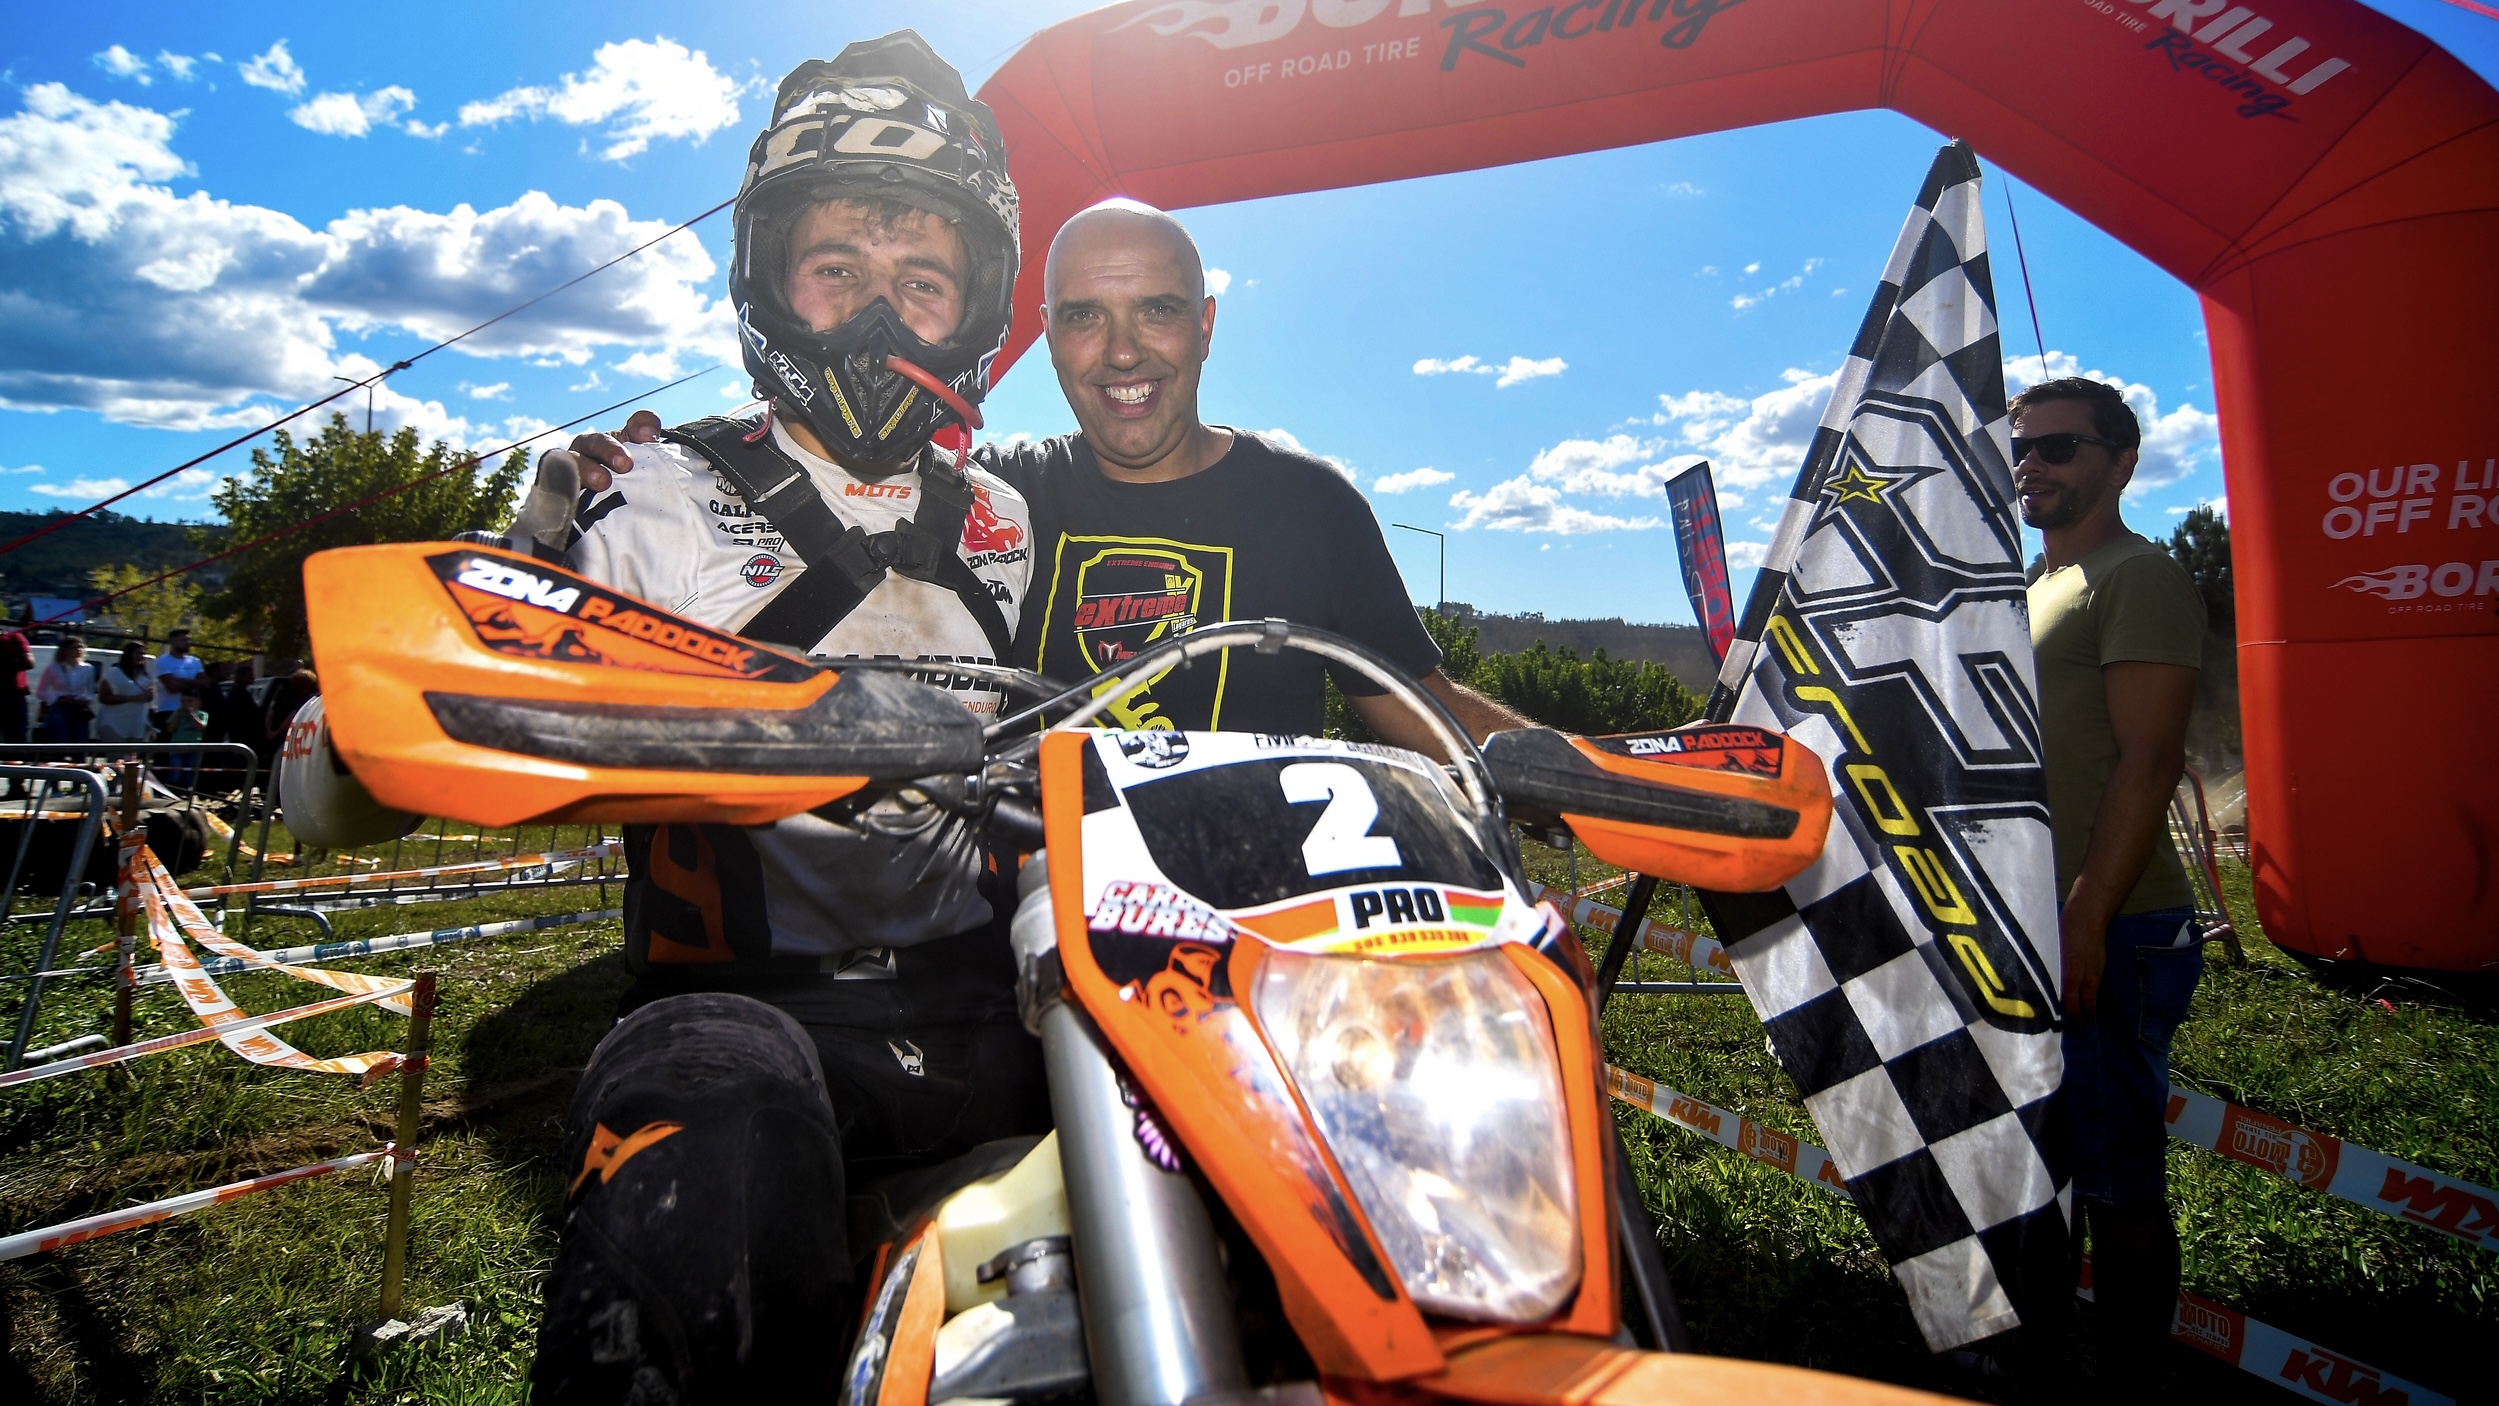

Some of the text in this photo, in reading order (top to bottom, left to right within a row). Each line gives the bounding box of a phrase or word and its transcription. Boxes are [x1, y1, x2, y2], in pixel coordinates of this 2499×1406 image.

[2115, 10, 2148, 34] TIRE
[1223, 37, 1421, 88] OFF ROAD TIRE
[2128, 0, 2352, 96] RILLI
[2144, 27, 2303, 124] Racing
[844, 483, 912, 499] MOTS
[2327, 459, 2499, 503] OUR LI
[2321, 497, 2434, 540] OFF
[740, 564, 785, 577] NILS
[458, 558, 757, 672] ZONA PADDOCK
[1073, 593, 1188, 628] eXtreme
[2387, 602, 2485, 615] OFF ROAD TIRE
[1625, 731, 1767, 755] ZONA PADDOCK
[1279, 762, 1402, 876] 2
[1350, 887, 1445, 929] PRO
[1668, 1095, 1721, 1136] KTM
[2279, 1346, 2409, 1406] KTM
